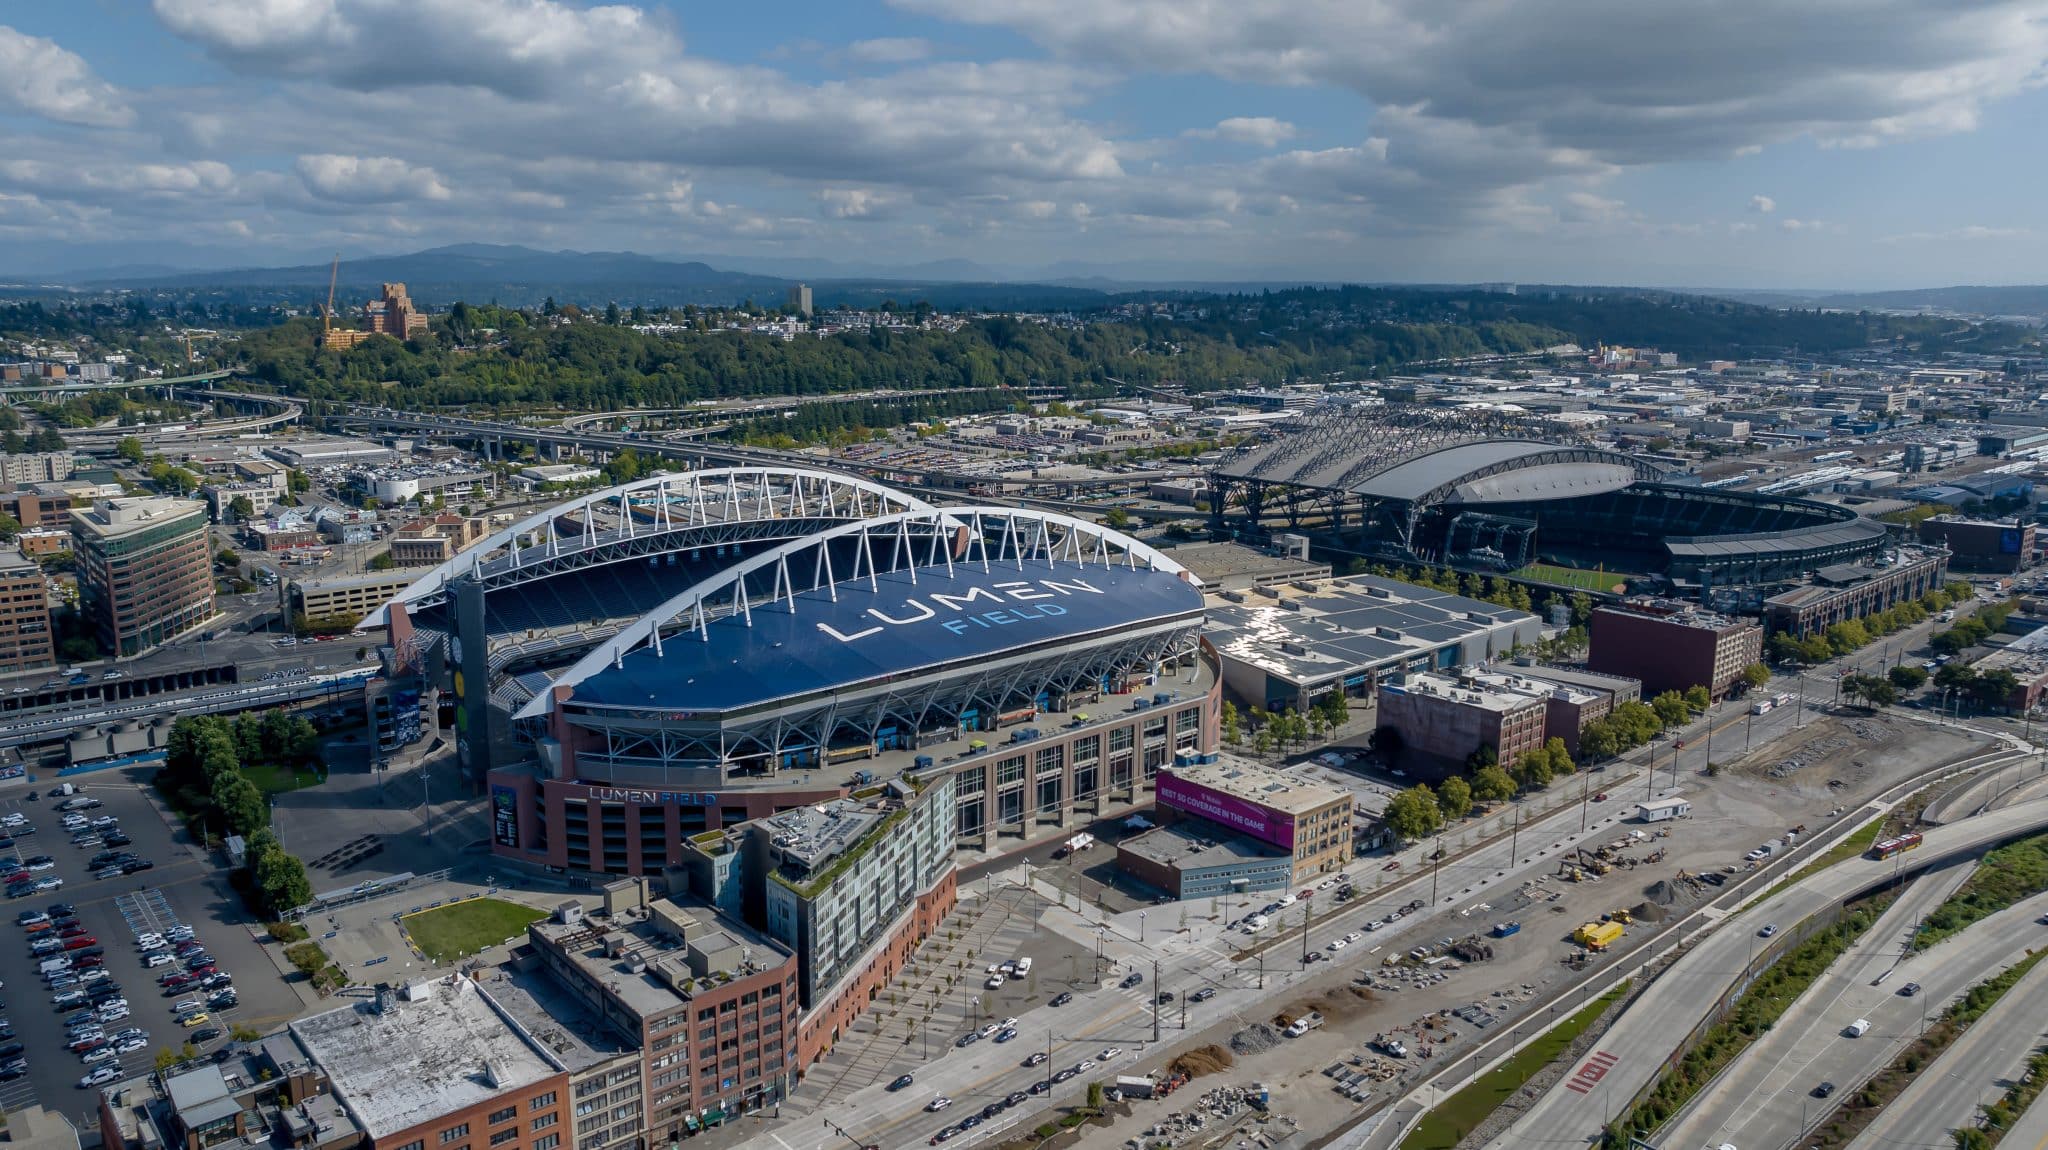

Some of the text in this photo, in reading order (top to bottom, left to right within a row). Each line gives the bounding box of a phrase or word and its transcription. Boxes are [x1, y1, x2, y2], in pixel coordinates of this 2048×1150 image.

[816, 579, 1104, 642] LUMEN
[940, 603, 1067, 635] FIELD
[1309, 656, 1430, 697] LUMEN EVENT CENTER
[589, 787, 717, 806] LUMEN FIELD
[1161, 787, 1176, 799] BEST
[1186, 796, 1222, 816] COVERAGE
[1230, 812, 1244, 824] THE
[1244, 817, 1265, 832] GAME
